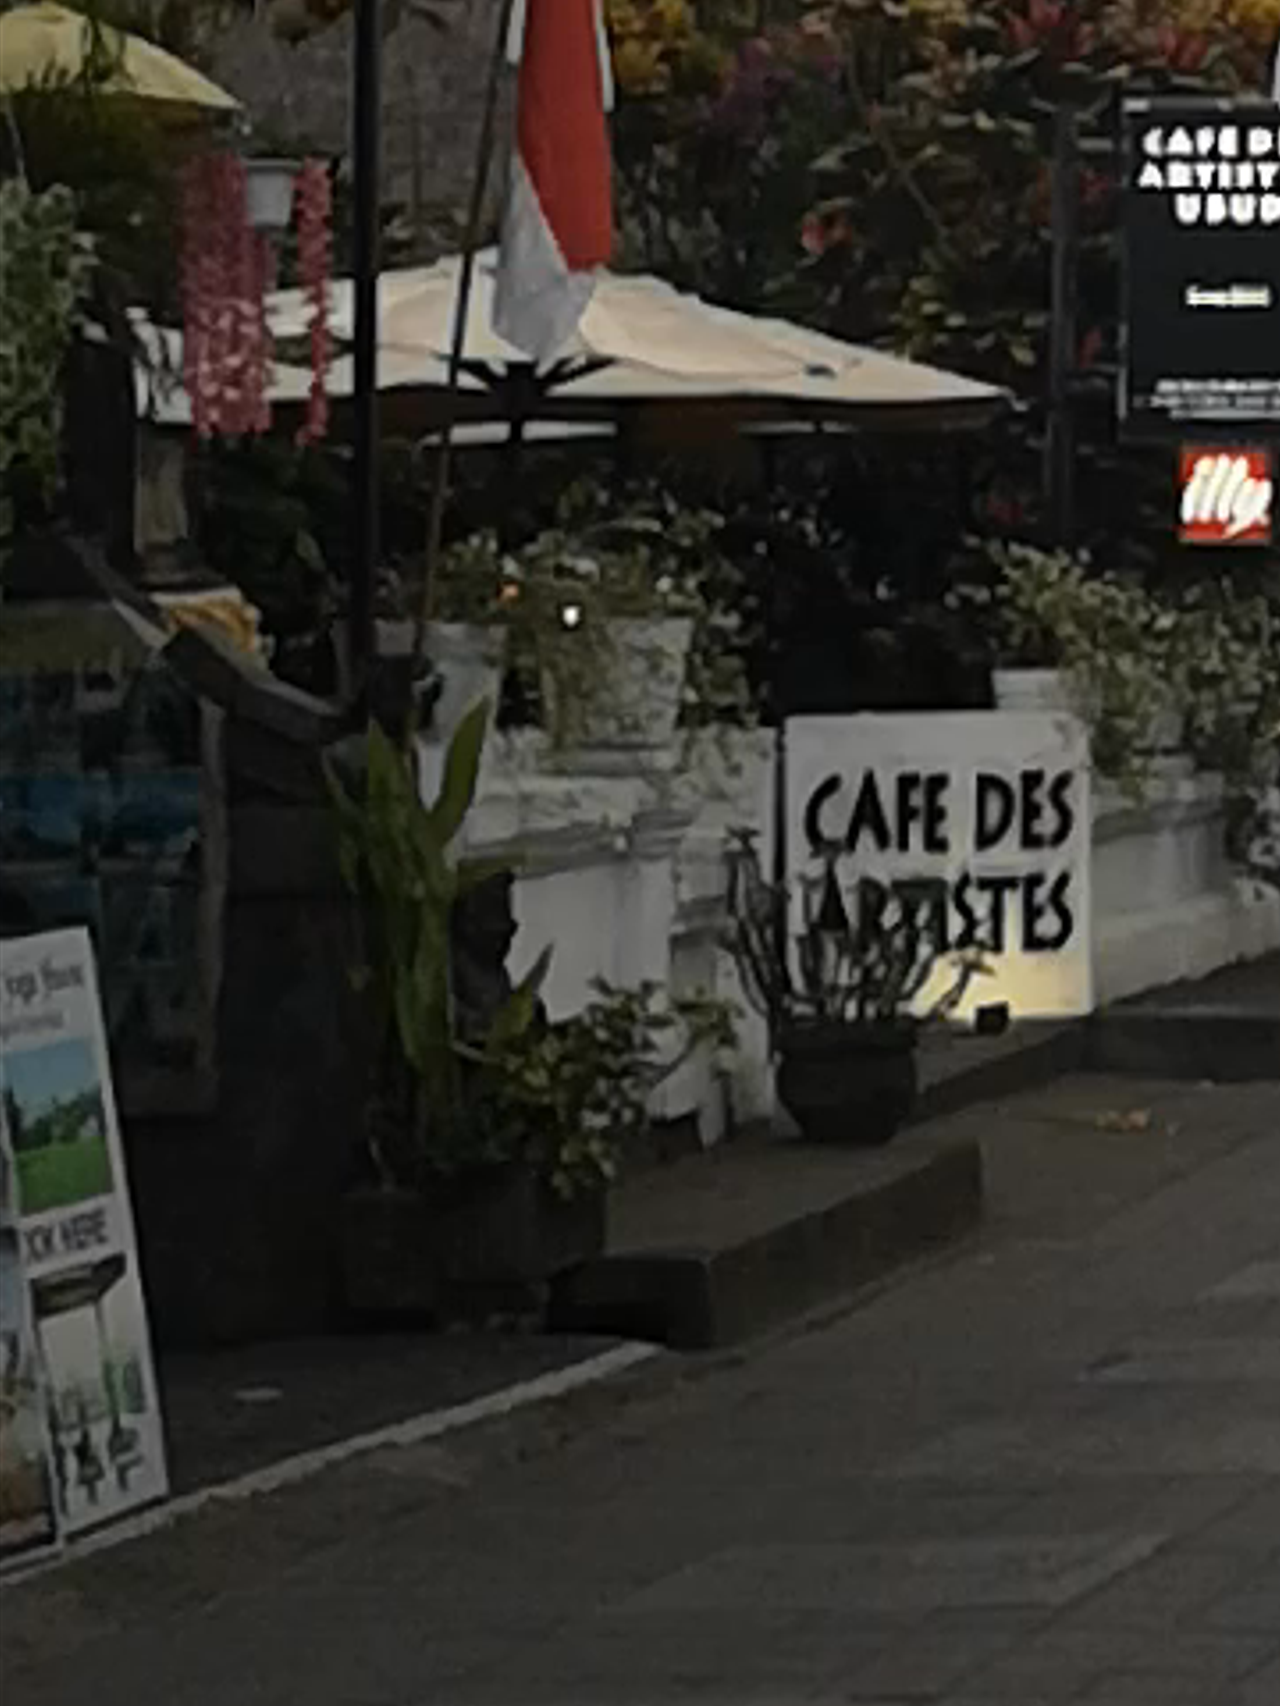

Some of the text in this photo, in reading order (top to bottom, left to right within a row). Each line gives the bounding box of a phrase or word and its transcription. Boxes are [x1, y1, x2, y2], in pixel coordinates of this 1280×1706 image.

[1142, 127, 1238, 157] CAFE
[804, 769, 1075, 854] CAFE DES
